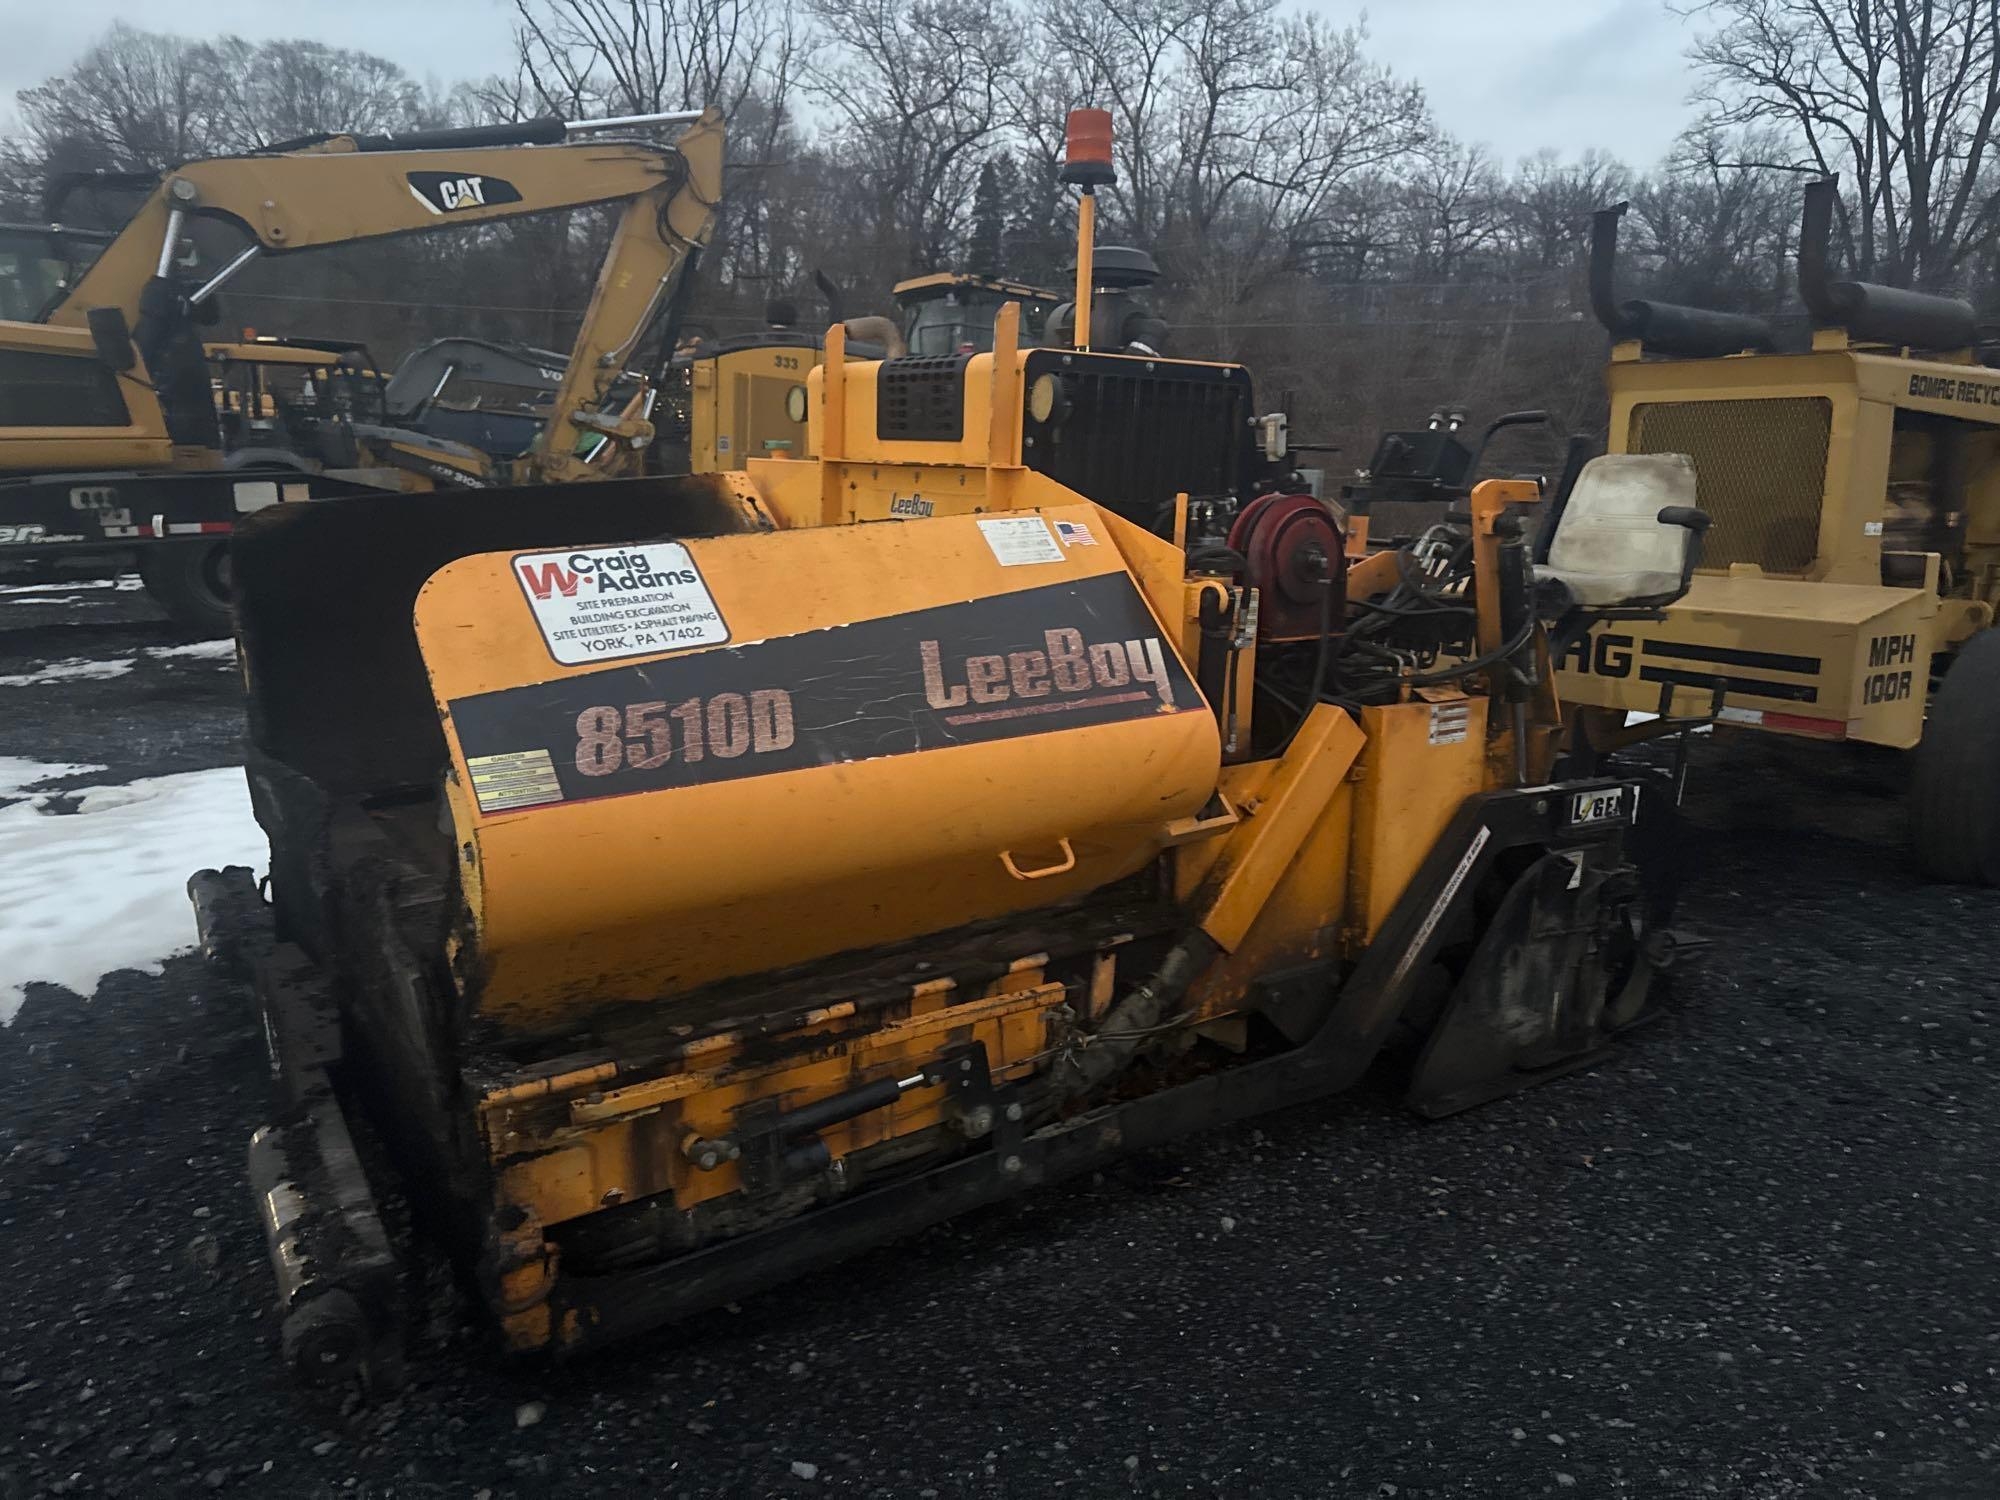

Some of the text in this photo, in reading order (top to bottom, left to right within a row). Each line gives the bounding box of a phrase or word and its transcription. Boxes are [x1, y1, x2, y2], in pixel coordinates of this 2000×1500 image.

[440, 177, 485, 209] CAT
[1909, 374, 1956, 399] BOMAG
[890, 492, 934, 517] LeeBoy
[568, 550, 651, 574] Craig
[598, 569, 697, 593] Adams
[570, 602, 692, 626] BUILDING EXCAVATION
[576, 592, 675, 611] SITE PREPARATION
[553, 612, 718, 641] SITE UTILITIES ASPHALT PAVING
[581, 626, 705, 653] YORK, PA 17402
[1868, 634, 1916, 667] MPH
[919, 627, 1175, 710] LeeBoy
[1863, 671, 1913, 705] 100R
[575, 688, 795, 777] 8510D
